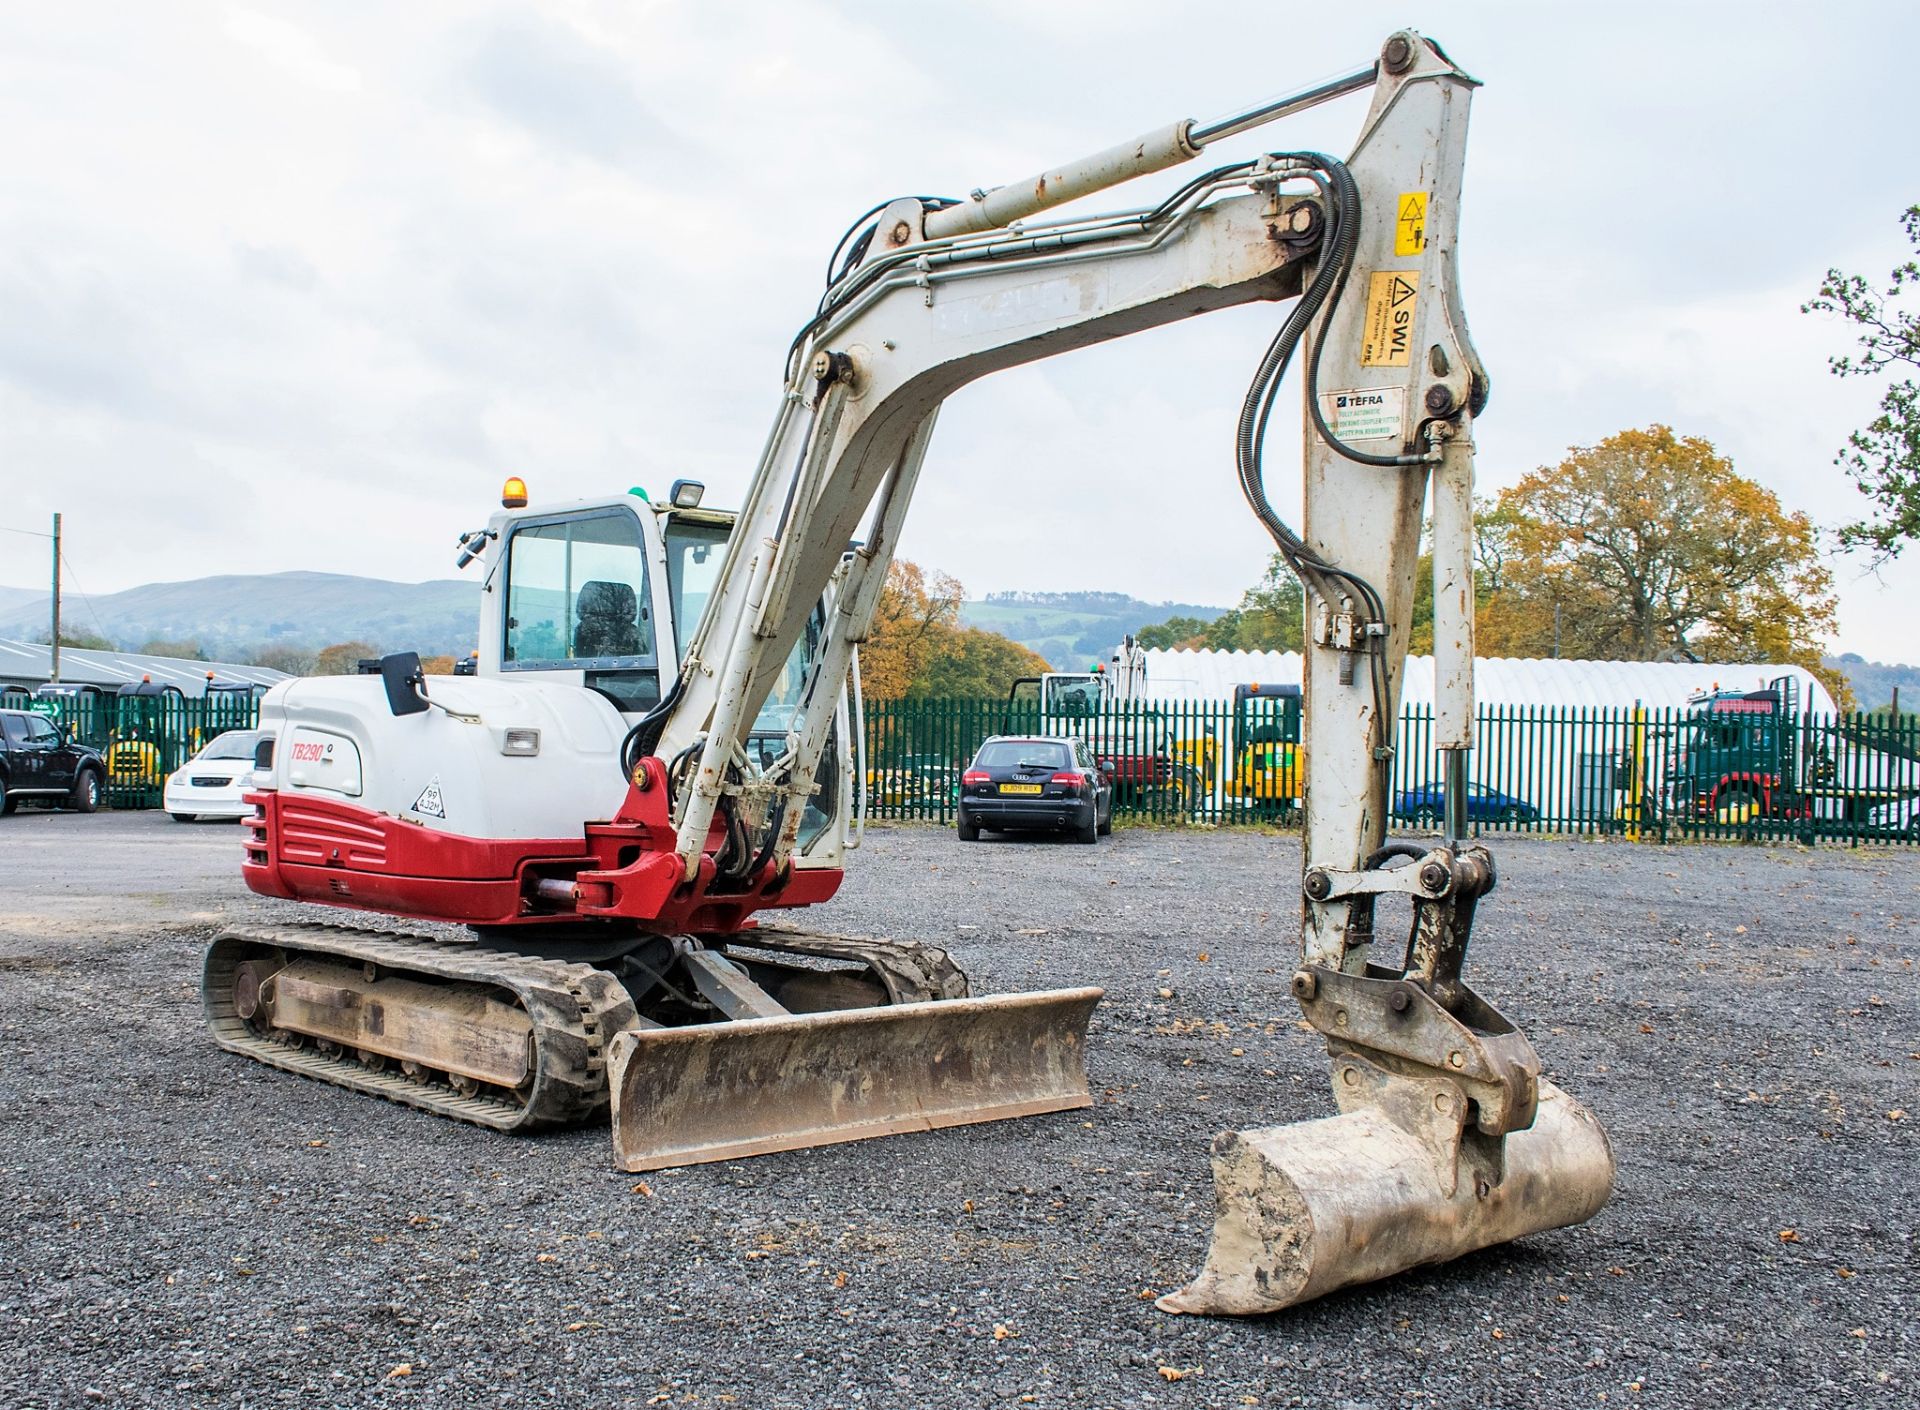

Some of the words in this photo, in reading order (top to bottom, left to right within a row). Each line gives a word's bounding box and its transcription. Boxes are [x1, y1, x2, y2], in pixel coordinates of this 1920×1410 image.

[1389, 310, 1410, 361] SWL
[1348, 396, 1383, 407] TEFRA
[291, 743, 324, 762] TB290
